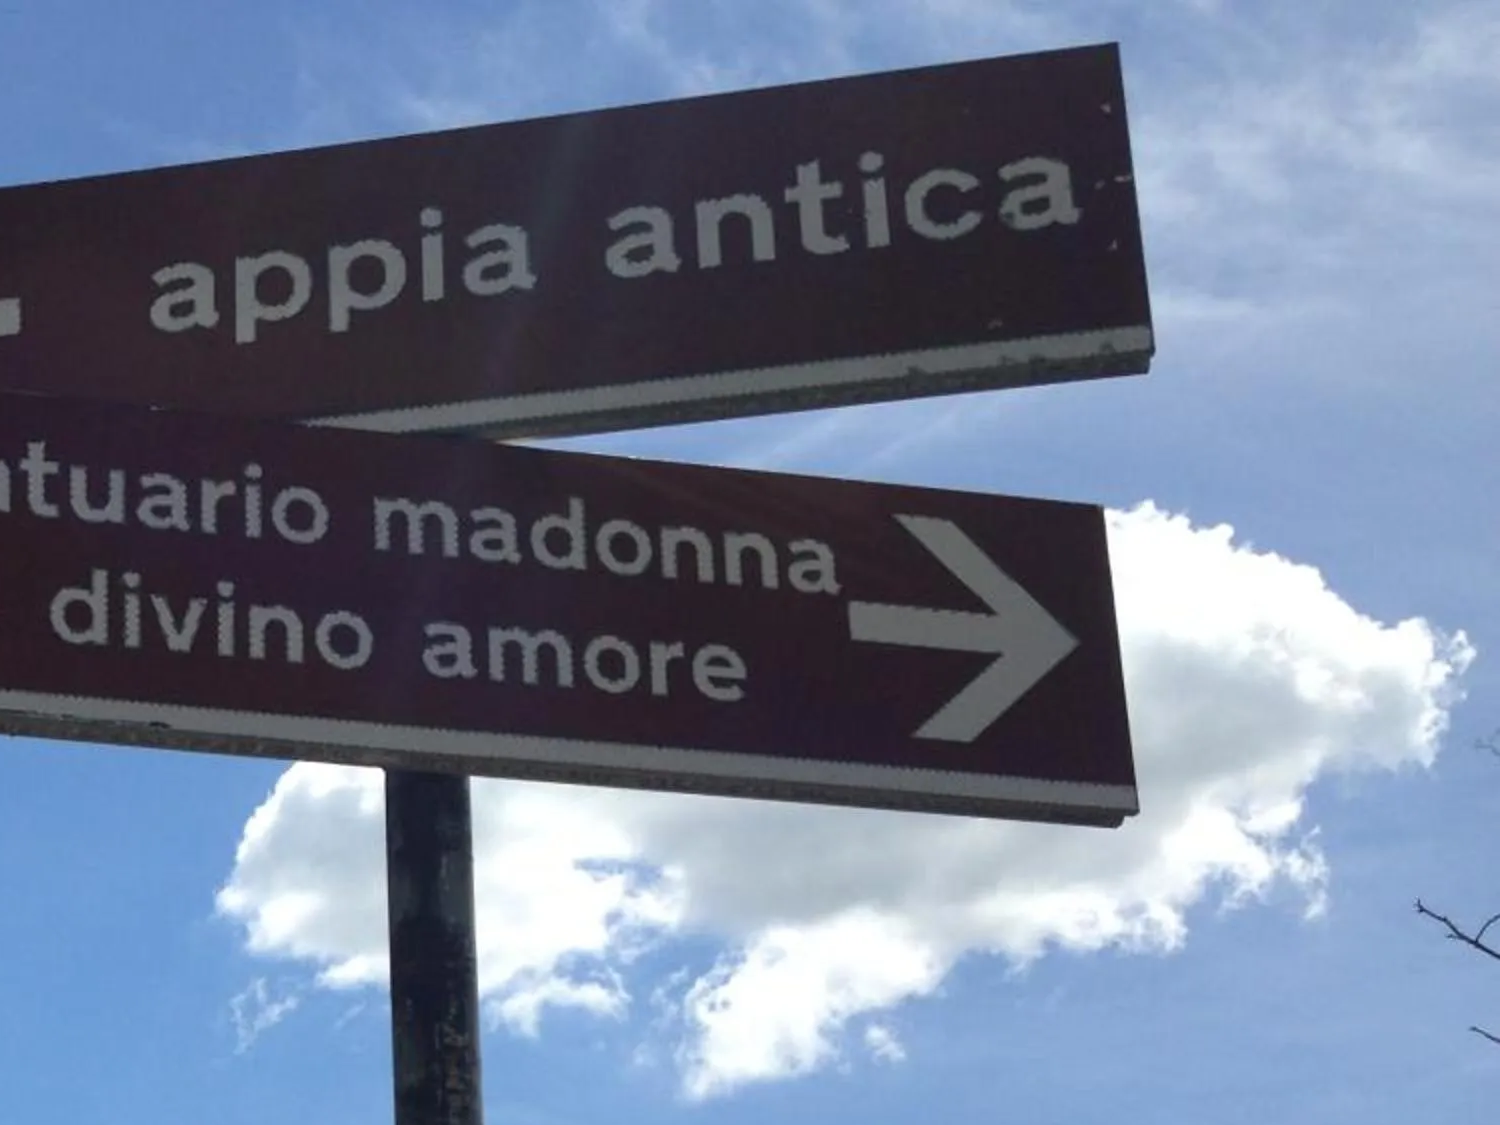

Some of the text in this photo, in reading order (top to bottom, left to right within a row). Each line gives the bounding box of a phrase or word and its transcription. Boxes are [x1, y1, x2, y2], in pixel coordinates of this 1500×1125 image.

[149, 152, 1078, 344] appia antica
[374, 498, 841, 593] madonna
[50, 569, 373, 670] divino
[422, 622, 747, 700] amore
